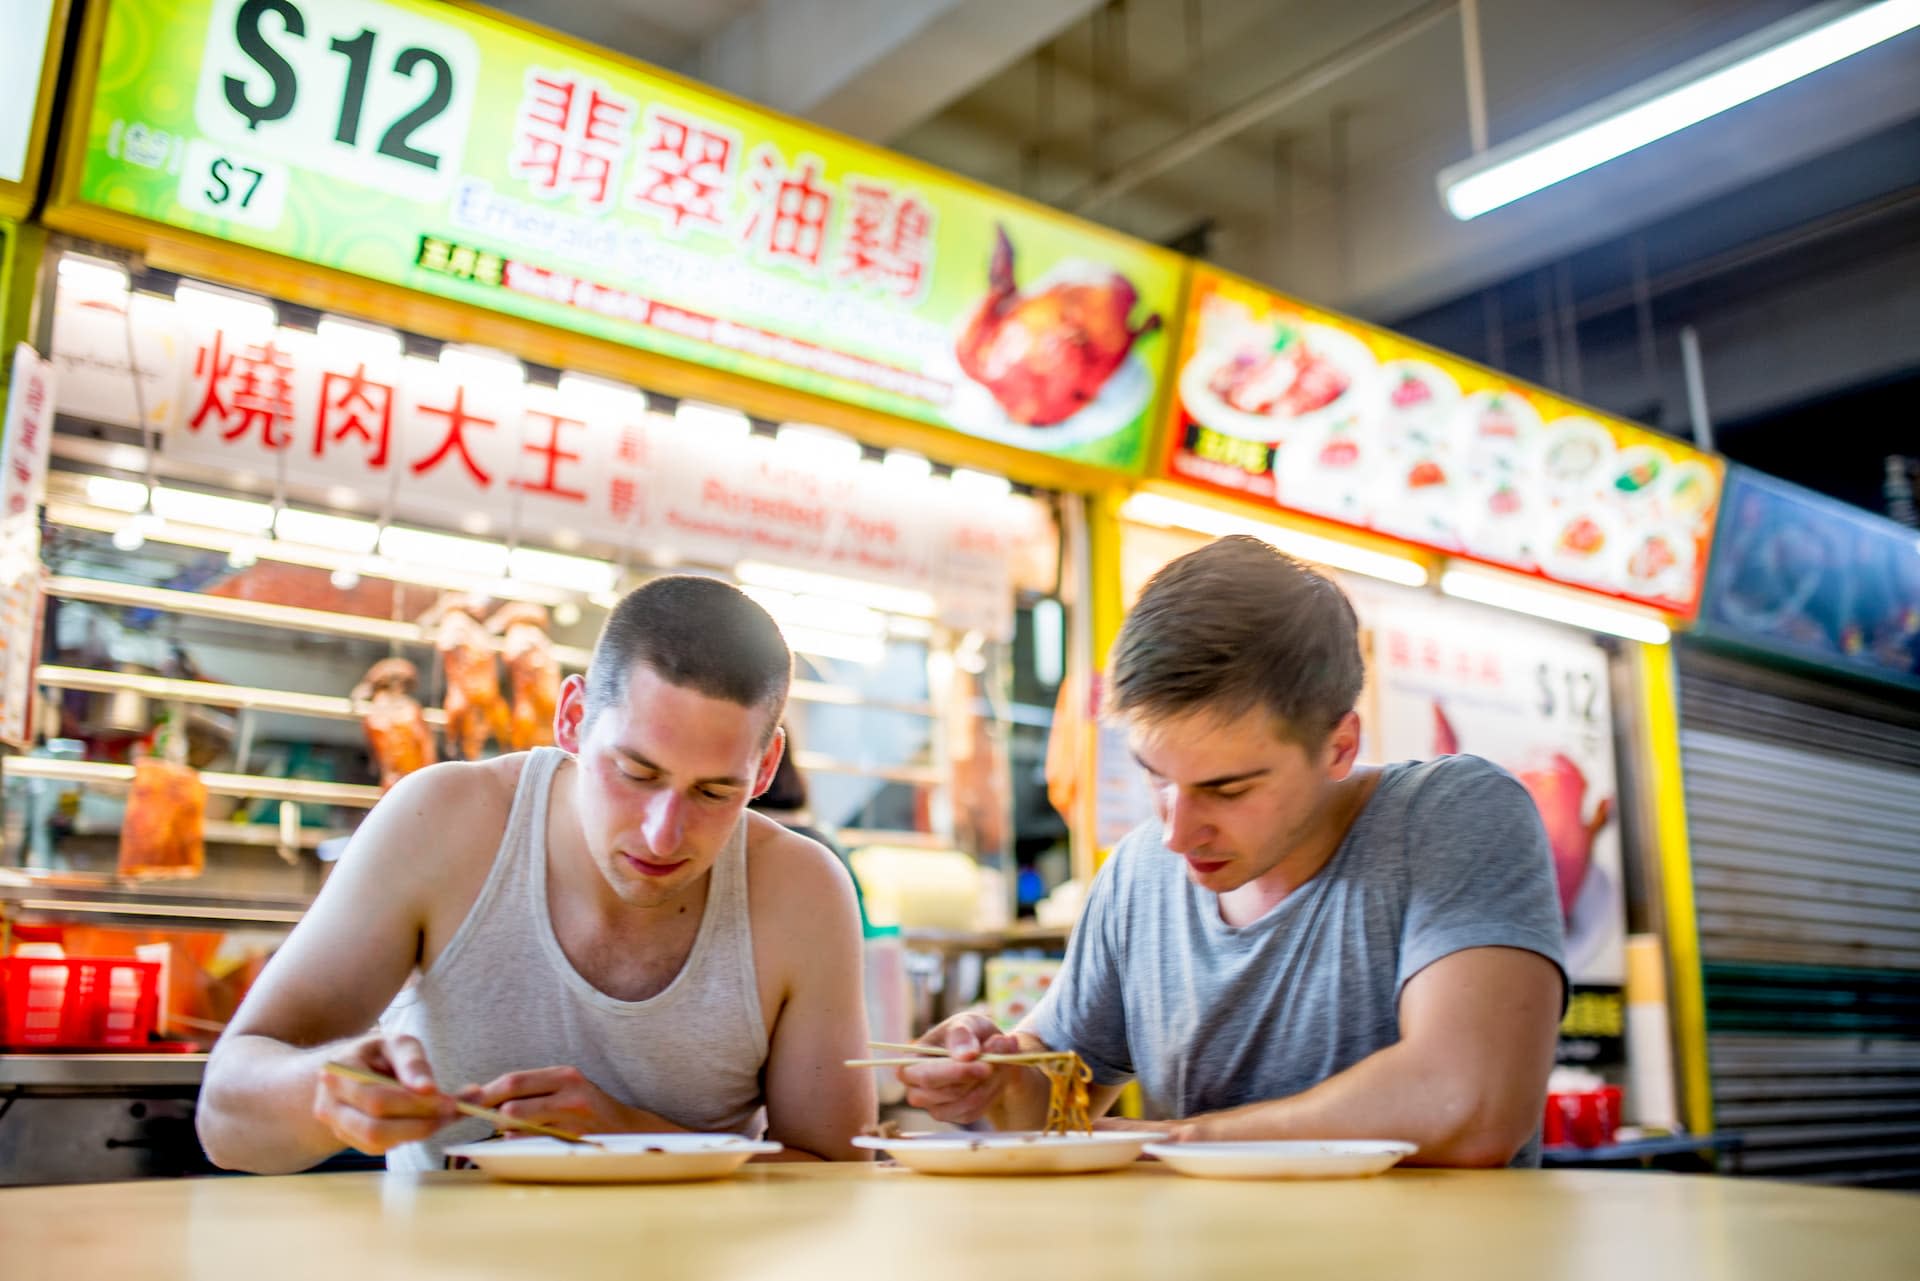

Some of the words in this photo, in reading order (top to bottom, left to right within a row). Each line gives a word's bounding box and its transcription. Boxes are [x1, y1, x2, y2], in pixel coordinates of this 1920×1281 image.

[223, 0, 453, 170] $12
[205, 157, 265, 208] $7
[188, 330, 588, 502] 燒肉大王
